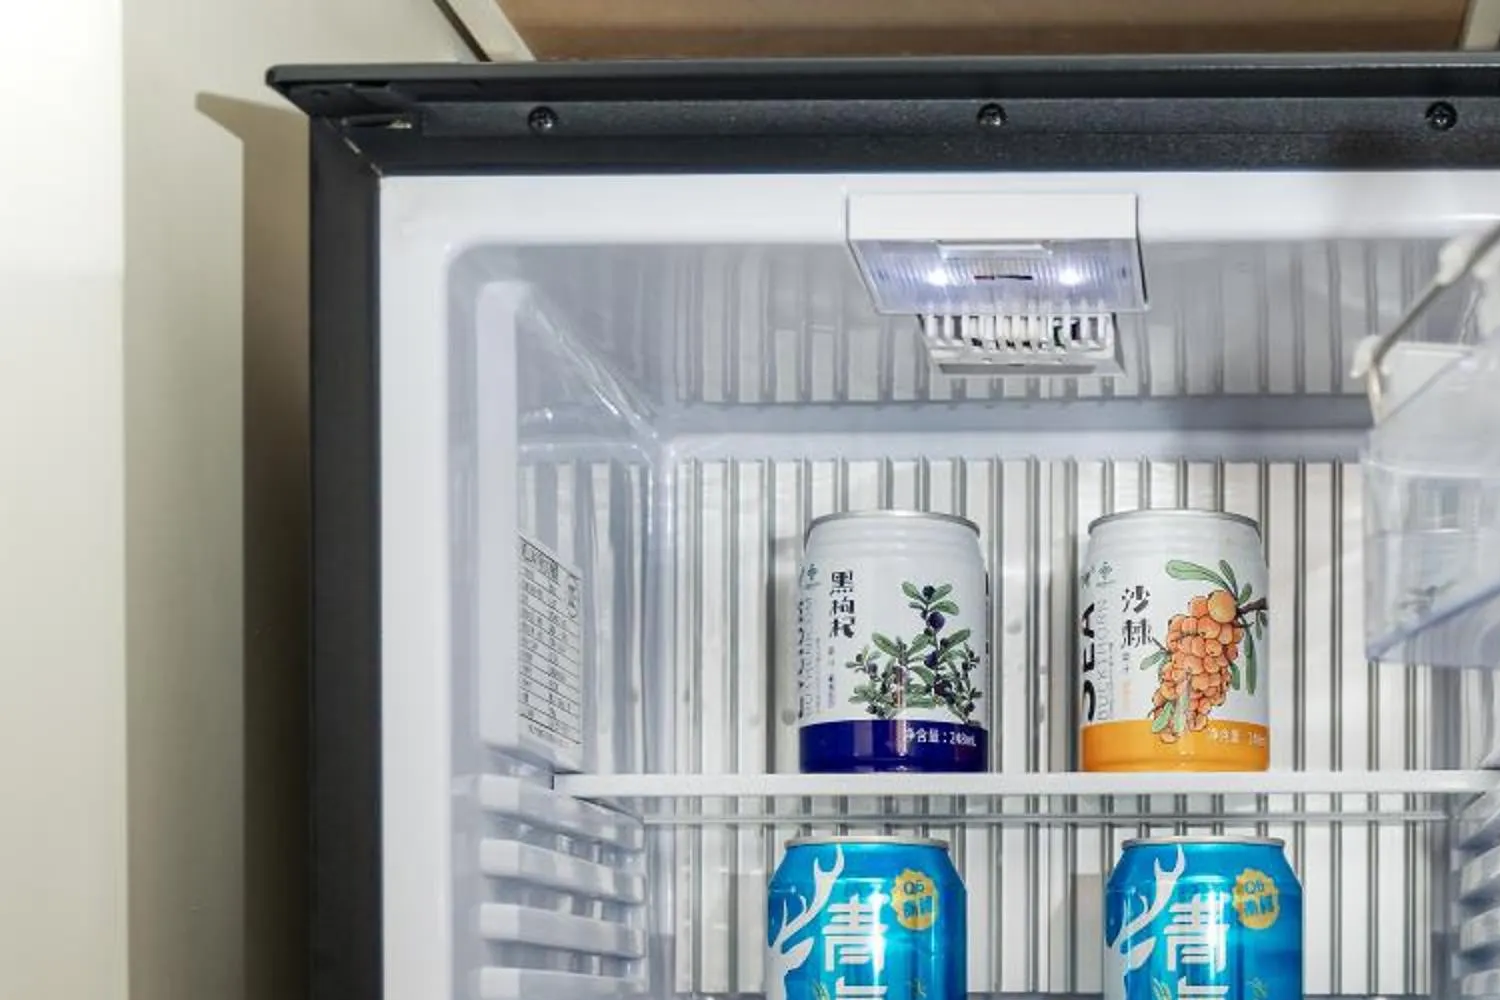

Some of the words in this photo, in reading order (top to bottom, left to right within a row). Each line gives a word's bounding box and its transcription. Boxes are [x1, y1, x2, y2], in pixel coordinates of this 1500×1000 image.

[829, 570, 855, 638] 黑枸杞
[1121, 585, 1151, 649] 沙棘
